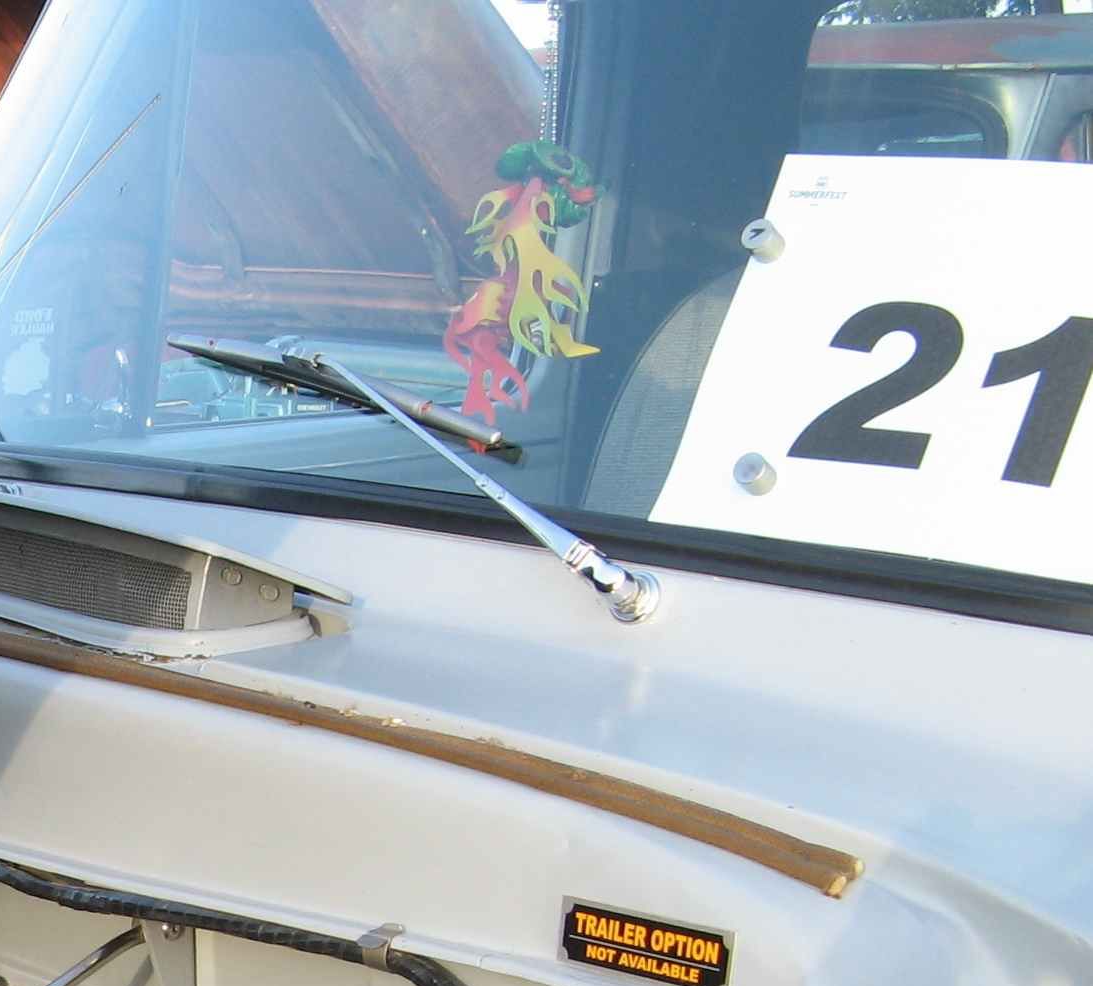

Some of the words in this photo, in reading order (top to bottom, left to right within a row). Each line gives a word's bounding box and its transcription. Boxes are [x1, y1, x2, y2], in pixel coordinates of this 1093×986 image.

[786, 300, 1093, 488] 21
[575, 911, 647, 948] TRAILER
[650, 929, 720, 965] OPTION
[585, 944, 617, 963] NOT
[618, 952, 699, 984] AVAILABLE
